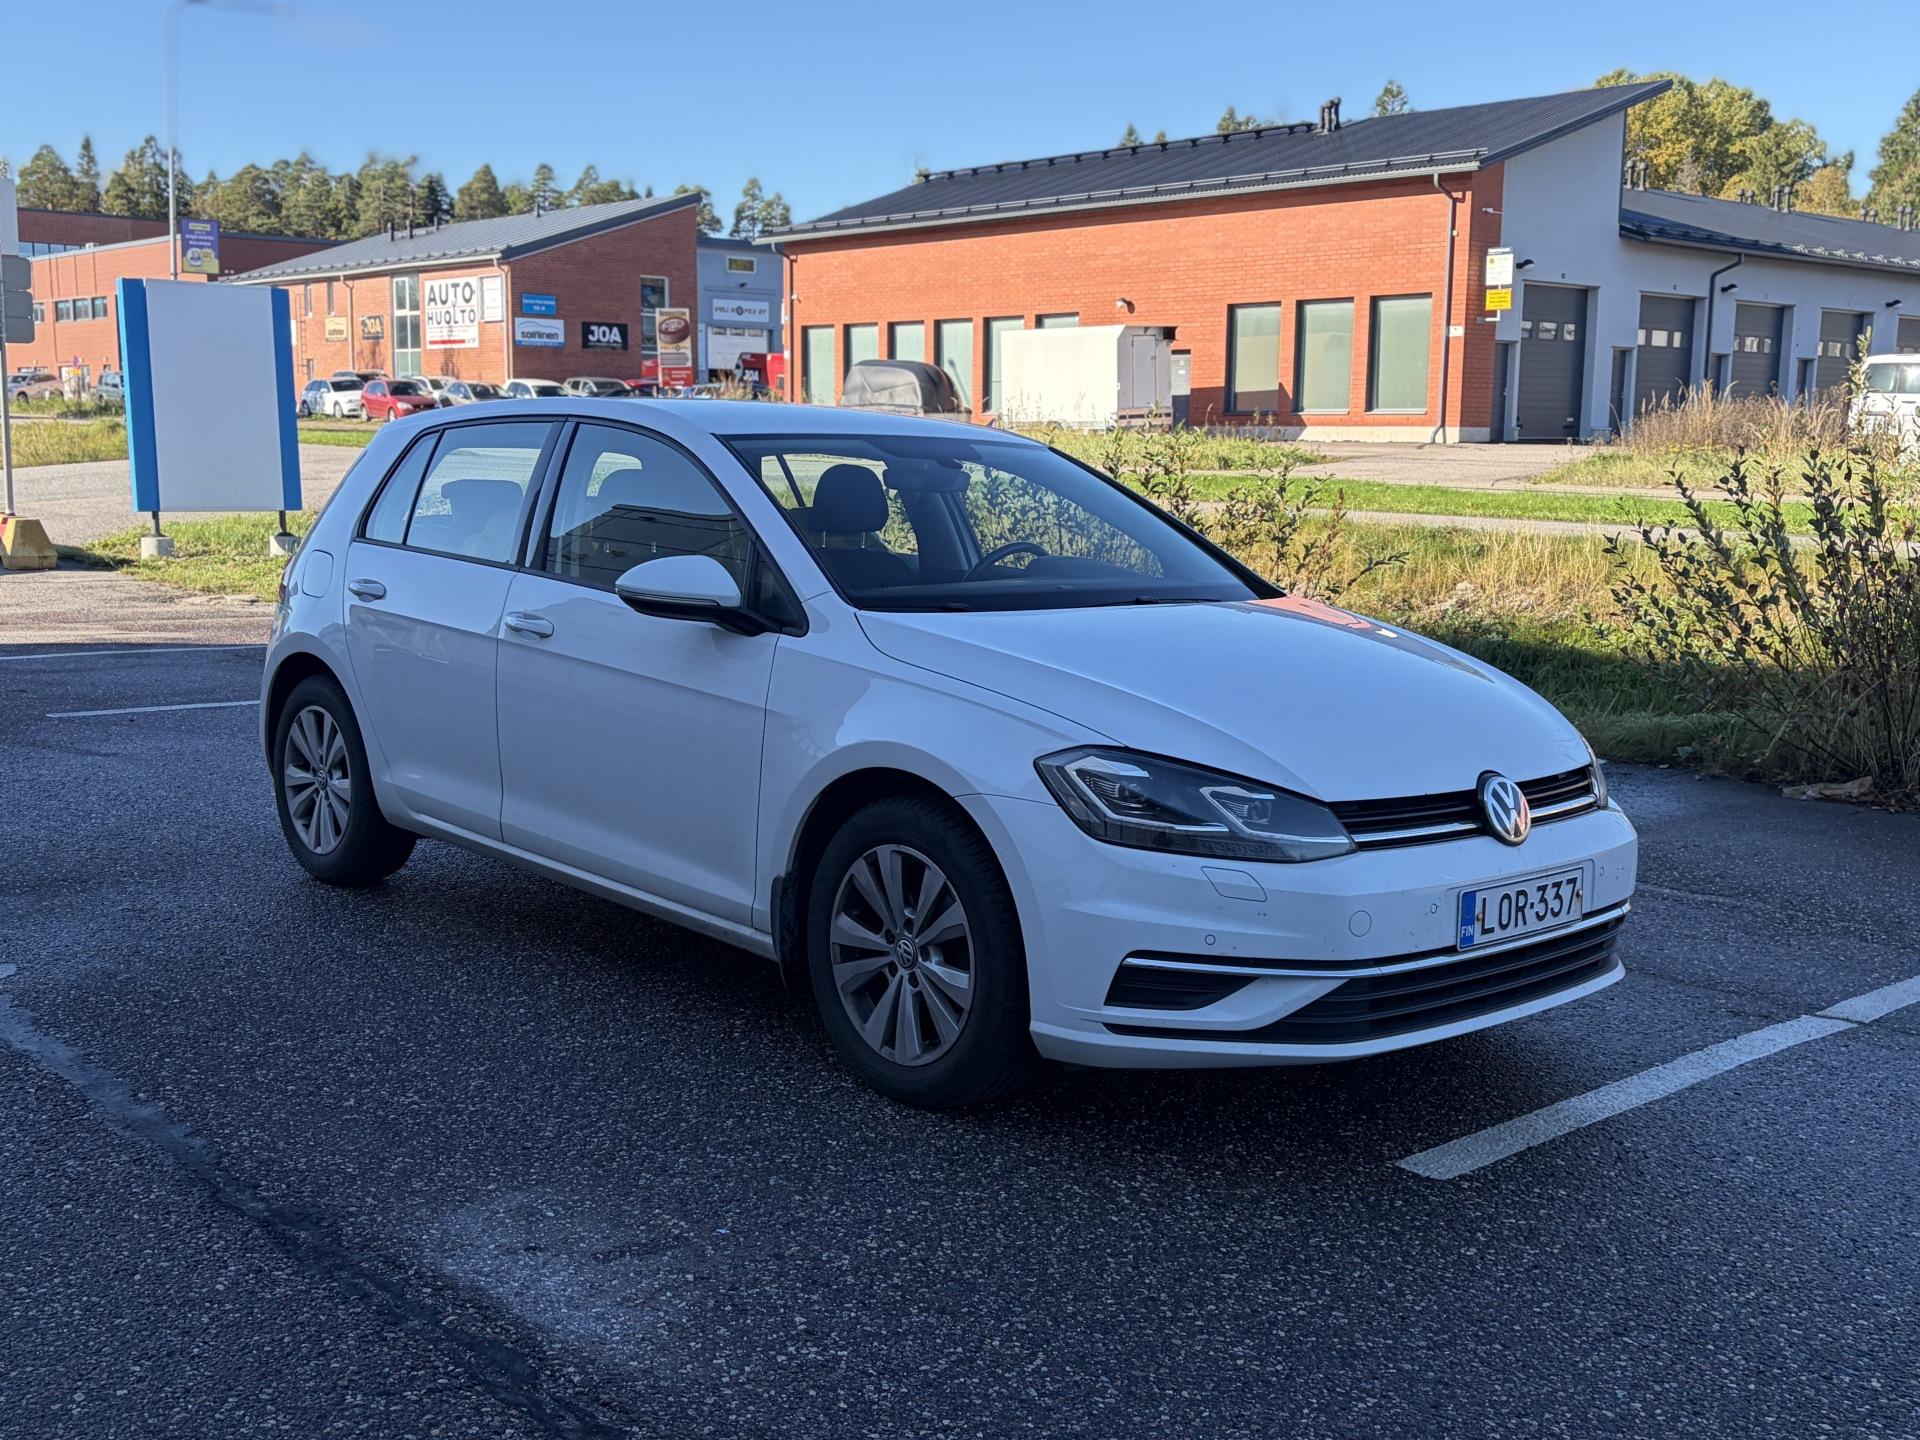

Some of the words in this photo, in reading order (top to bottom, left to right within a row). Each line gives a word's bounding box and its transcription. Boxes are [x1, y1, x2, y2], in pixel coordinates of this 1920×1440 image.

[427, 281, 475, 306] AUTO
[427, 309, 476, 325] HUOLTO
[588, 325, 622, 343] JOA
[1481, 877, 1578, 935] LOR-337
[1461, 924, 1474, 938] FIN
